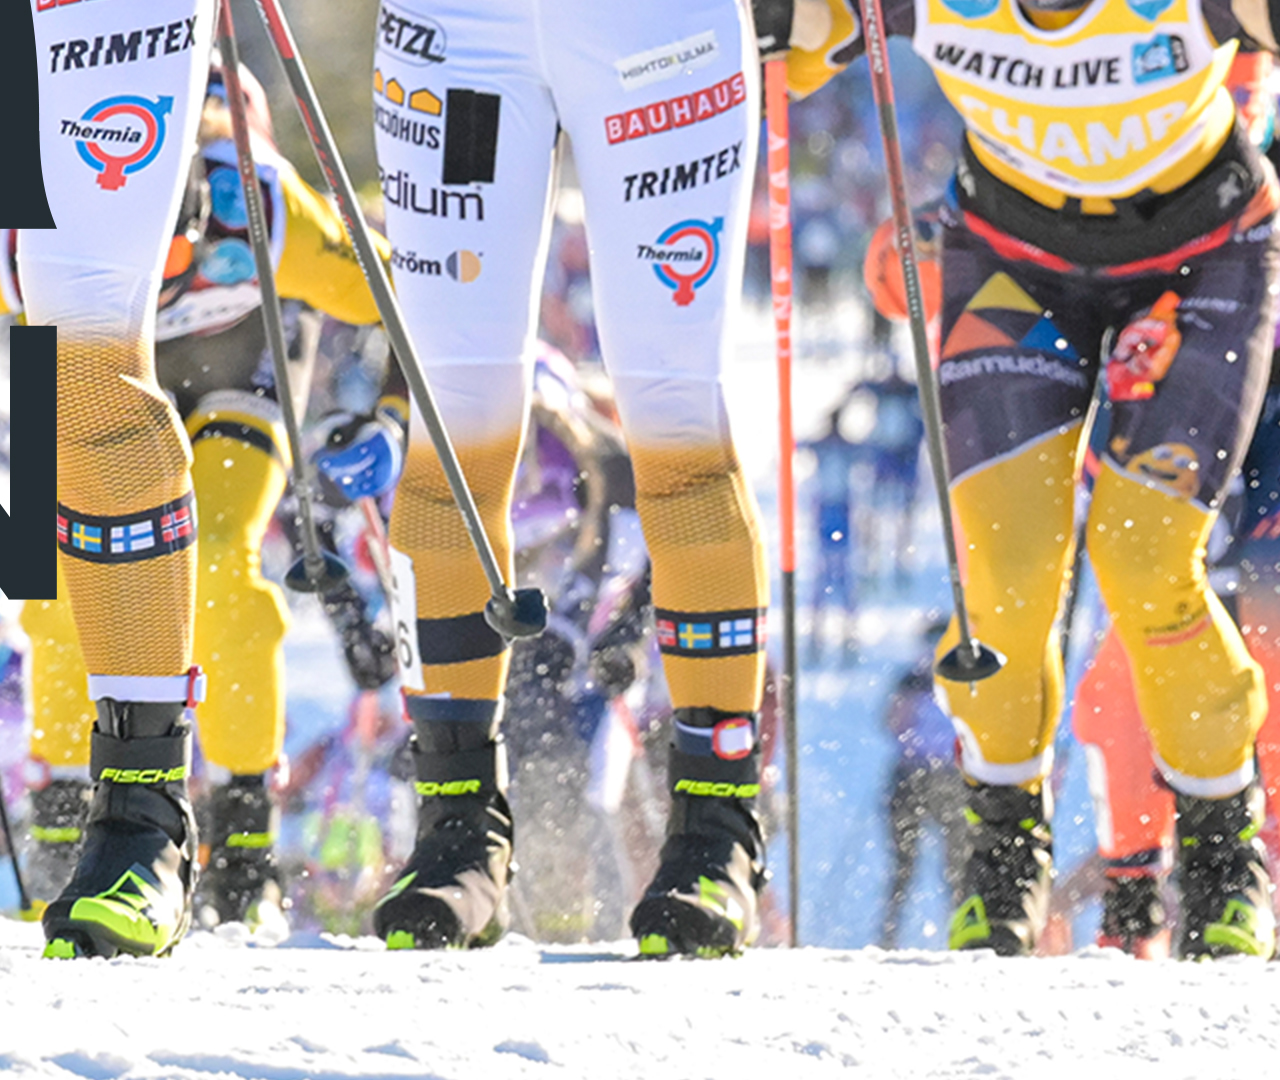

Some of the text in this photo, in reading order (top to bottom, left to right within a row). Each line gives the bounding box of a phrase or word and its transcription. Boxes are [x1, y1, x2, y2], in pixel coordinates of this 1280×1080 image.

[50, 15, 198, 73] TRIMTEX
[934, 42, 1121, 89] WATCH LIVE
[605, 71, 746, 143] BAUHAUS
[59, 119, 142, 145] Thermia
[623, 141, 743, 202] TRIMTEX
[636, 244, 704, 262] Thermia
[100, 765, 187, 784] FISCHE
[674, 779, 761, 797] FISCHE
